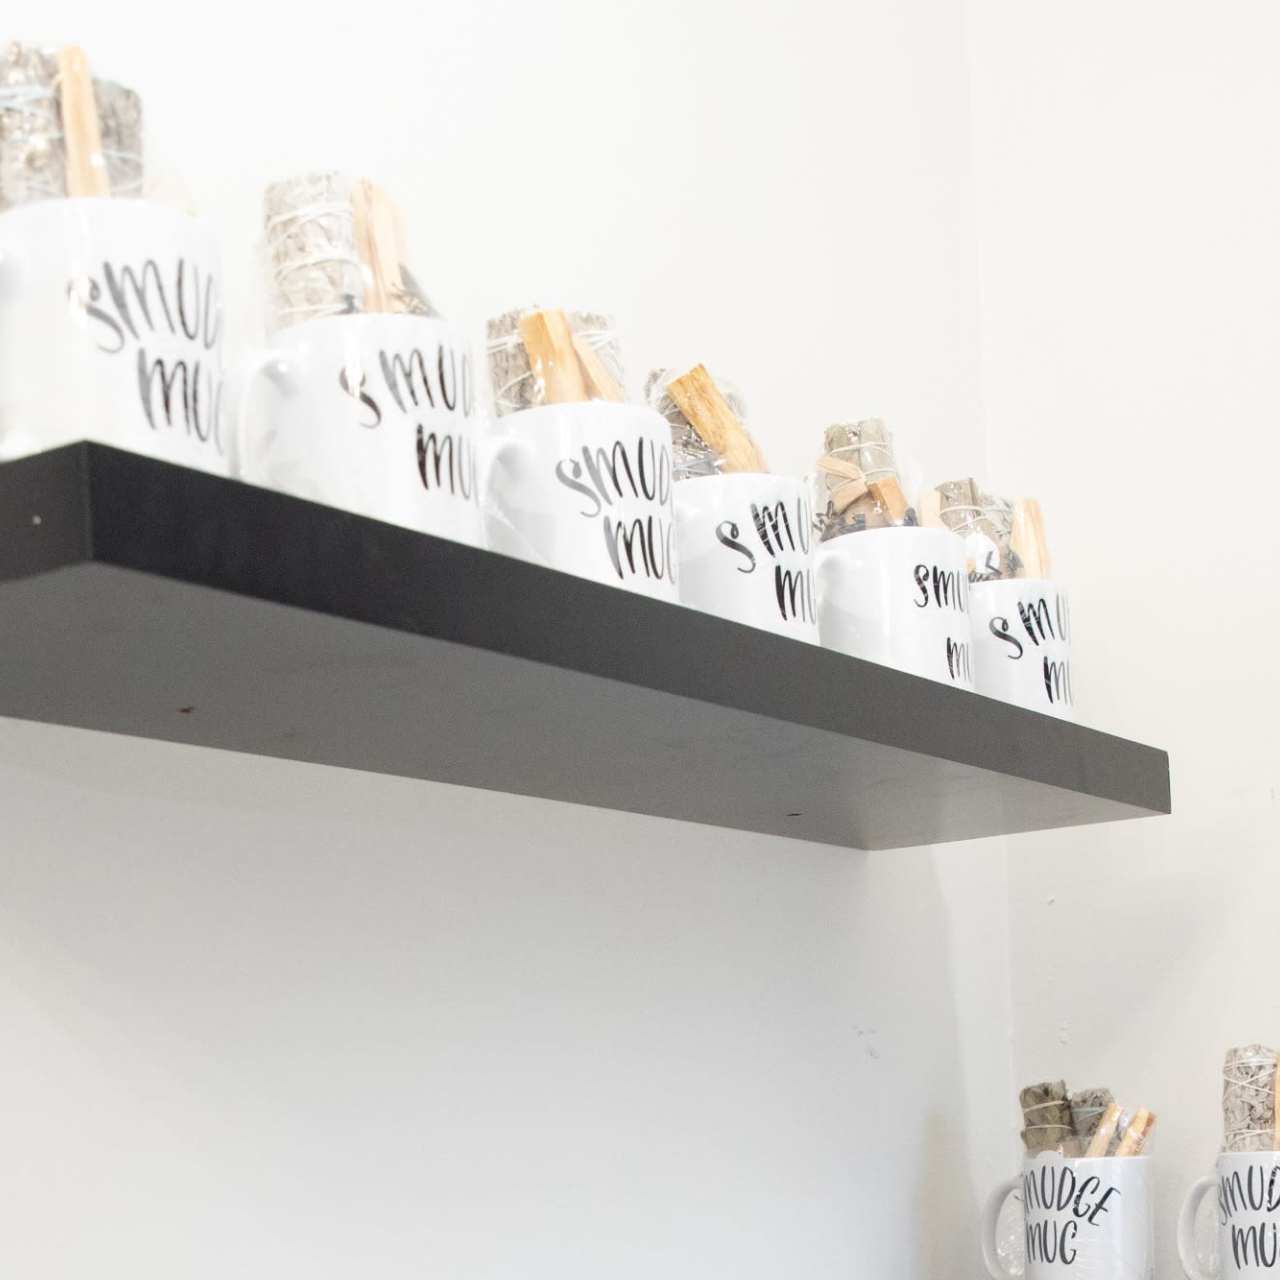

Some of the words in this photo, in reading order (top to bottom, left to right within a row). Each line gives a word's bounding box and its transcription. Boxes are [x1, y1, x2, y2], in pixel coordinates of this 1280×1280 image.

[415, 422, 481, 509] MU
[988, 591, 1072, 661] SMU
[1023, 1164, 1122, 1228] MUDGE
[1024, 1219, 1078, 1266] MUG
